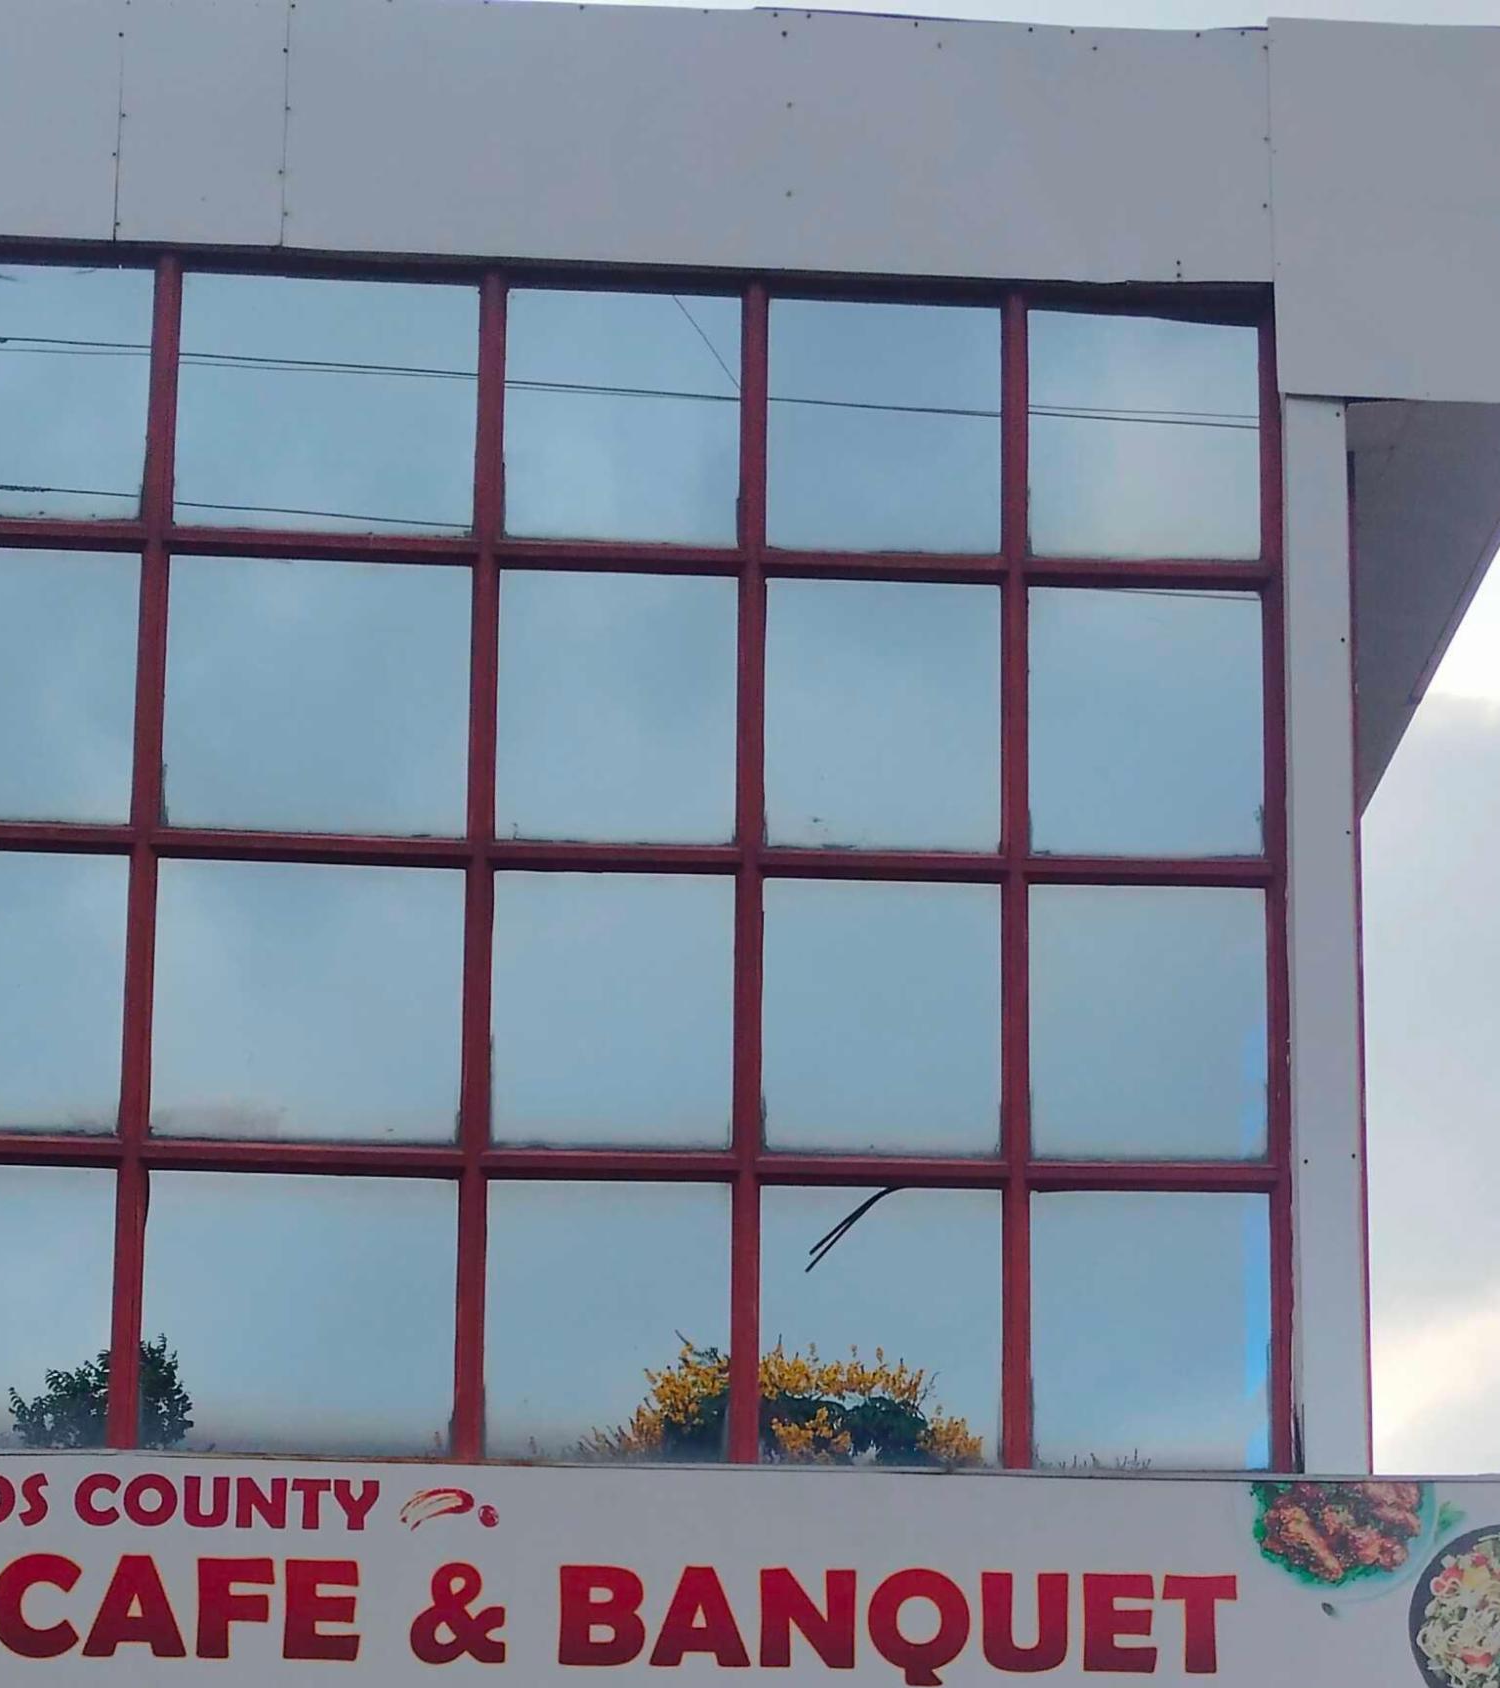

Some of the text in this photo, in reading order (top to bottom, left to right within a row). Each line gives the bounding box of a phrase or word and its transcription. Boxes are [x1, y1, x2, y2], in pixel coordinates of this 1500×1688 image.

[74, 1472, 380, 1532] COUNTY
[409, 1561, 506, 1666] &
[557, 1563, 1239, 1688] BANQUET
